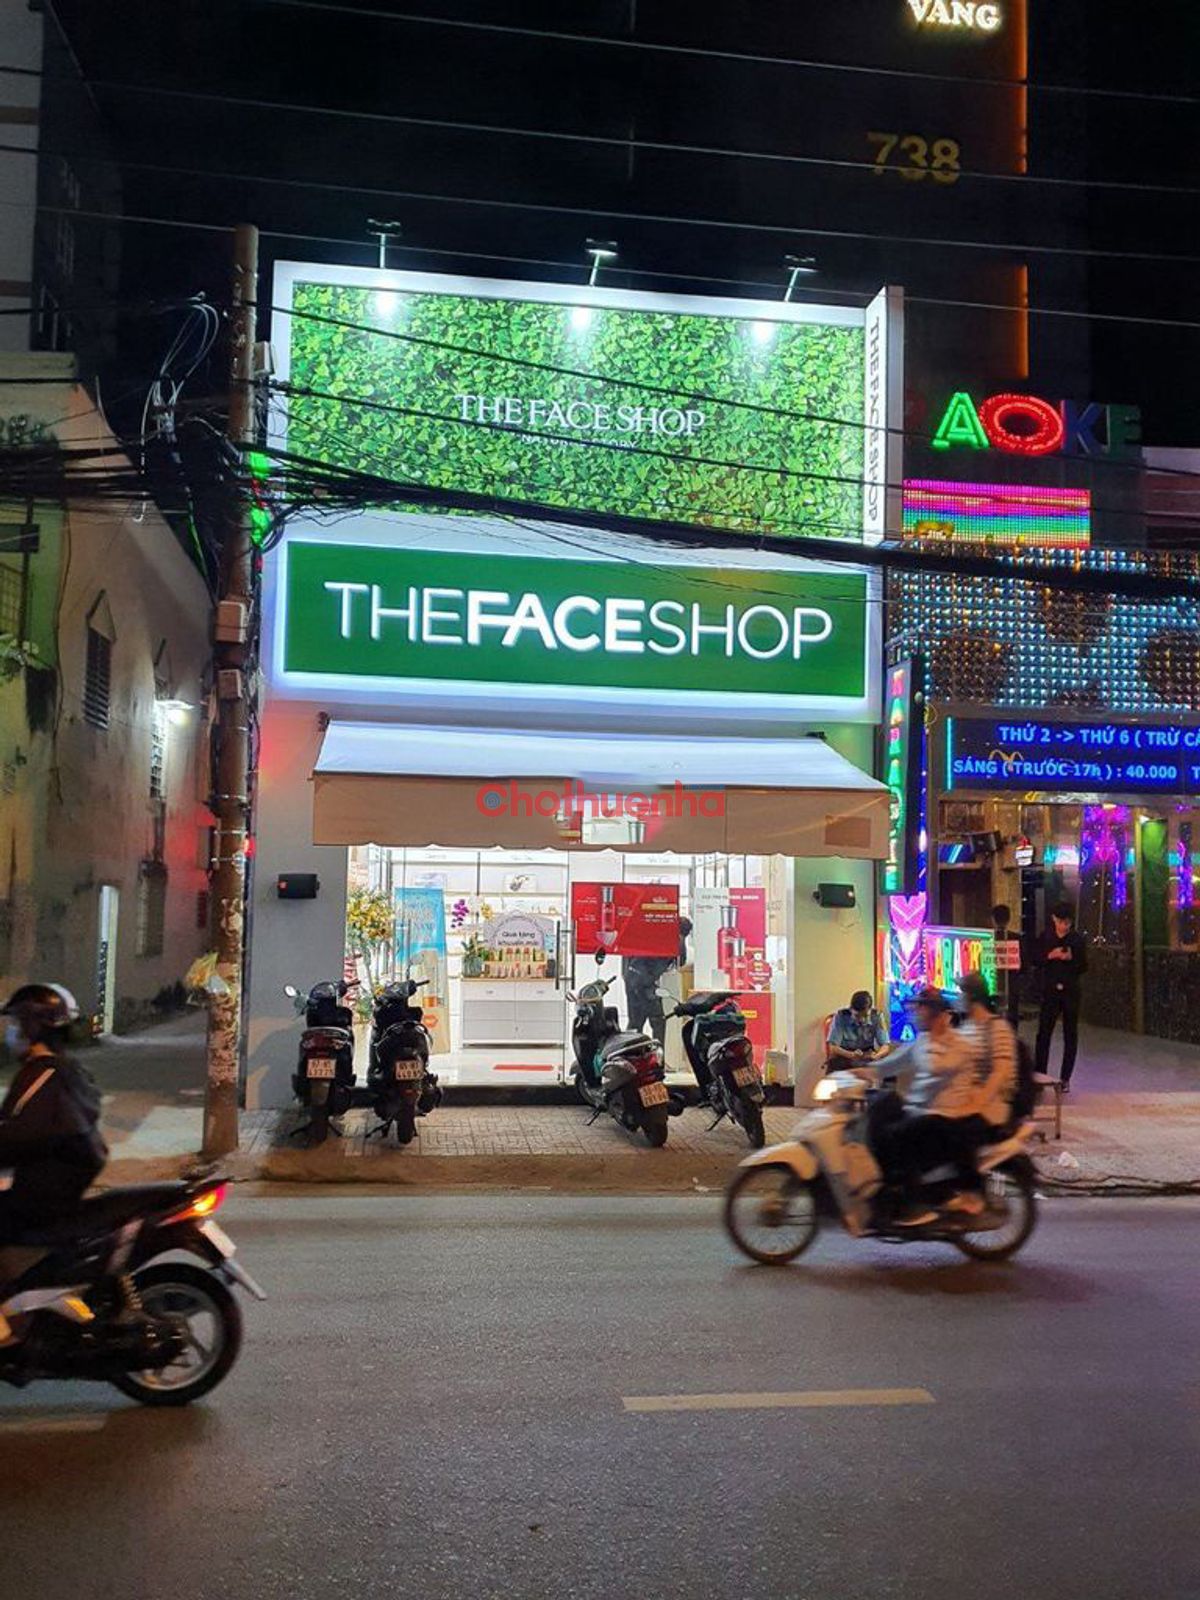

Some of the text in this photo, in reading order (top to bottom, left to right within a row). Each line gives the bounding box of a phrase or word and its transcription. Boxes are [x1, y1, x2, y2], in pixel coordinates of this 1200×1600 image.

[866, 131, 961, 183] 738
[999, 722, 1036, 742] THỨ
[1041, 730, 1051, 742] 2
[1080, 725, 1115, 744] THỨ
[1120, 729, 1130, 744] 6
[953, 755, 997, 773] SÁNG
[1126, 765, 1177, 779] 40.000
